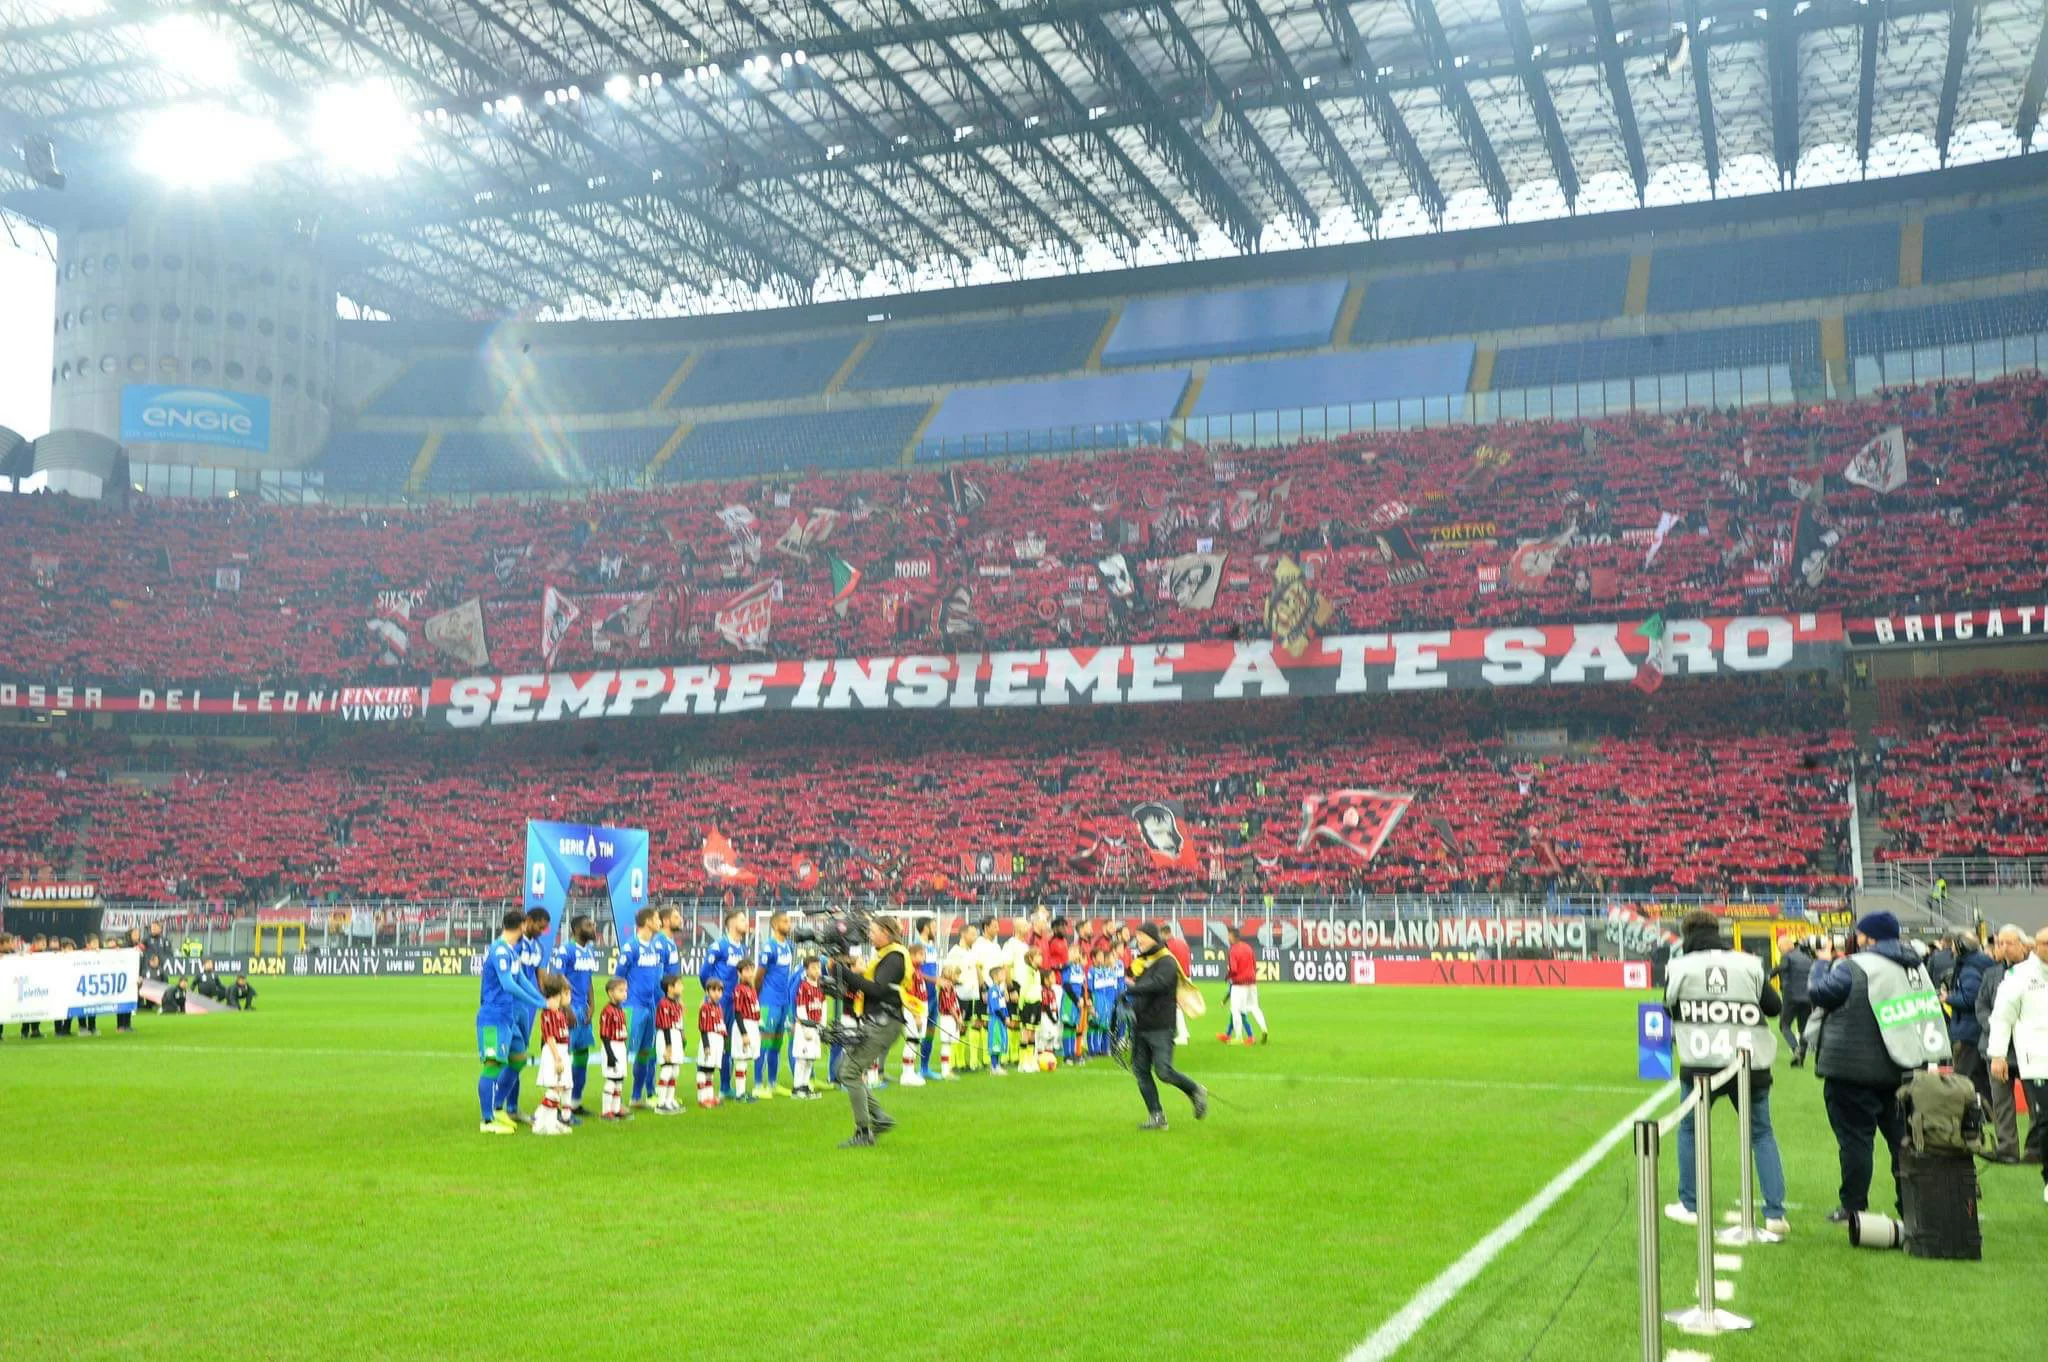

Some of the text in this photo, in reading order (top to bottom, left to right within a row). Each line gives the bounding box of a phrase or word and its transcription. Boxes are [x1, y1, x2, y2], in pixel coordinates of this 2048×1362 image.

[446, 661, 776, 728] SEMPRE
[791, 643, 1184, 708] INSIEME
[1322, 631, 1450, 693] TE
[139, 687, 200, 710] DEI
[1302, 919, 1440, 947] TOSCOLANO
[1442, 917, 1587, 949] MADERNO
[249, 957, 287, 974] DAZN
[314, 957, 360, 975] MILAN
[363, 957, 380, 974] TV
[422, 957, 462, 975] DAZN
[1293, 961, 1347, 981] 00:00
[1472, 961, 1567, 985] MILAN
[76, 972, 128, 997] 45510
[1680, 1000, 1760, 1027] PHOTO
